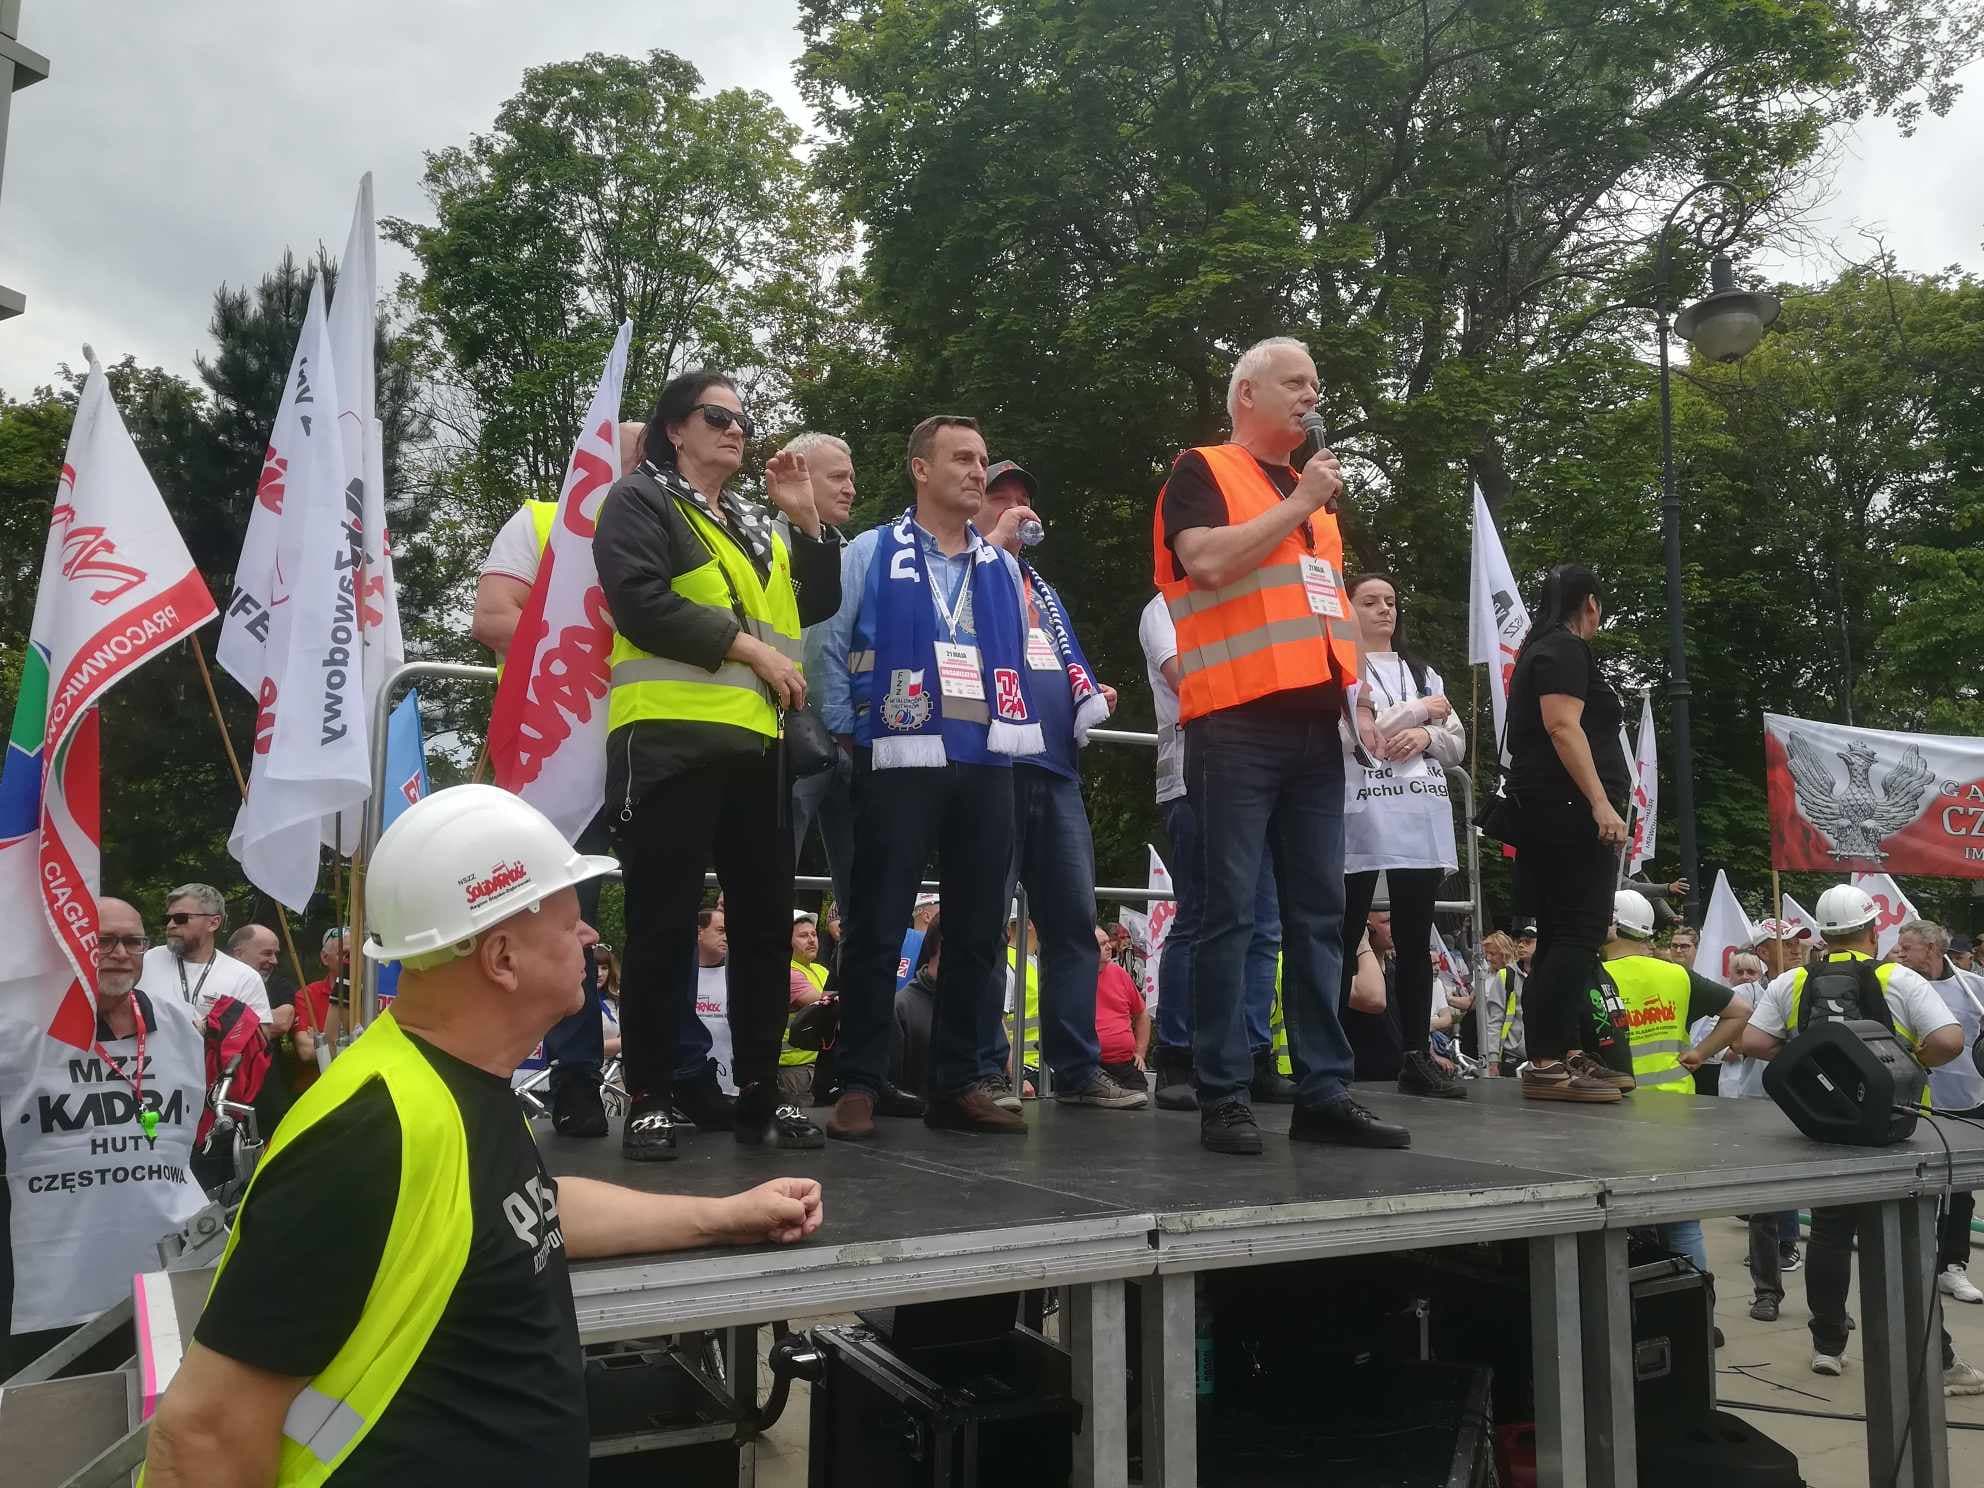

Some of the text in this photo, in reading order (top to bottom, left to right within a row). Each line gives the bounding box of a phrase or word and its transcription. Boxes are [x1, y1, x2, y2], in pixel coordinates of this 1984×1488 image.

[69, 1056, 155, 1083] MZZ
[38, 1089, 183, 1133] KADRA
[91, 1136, 156, 1155] HUTY
[28, 1163, 187, 1194] CZĘSTOCHOWA
